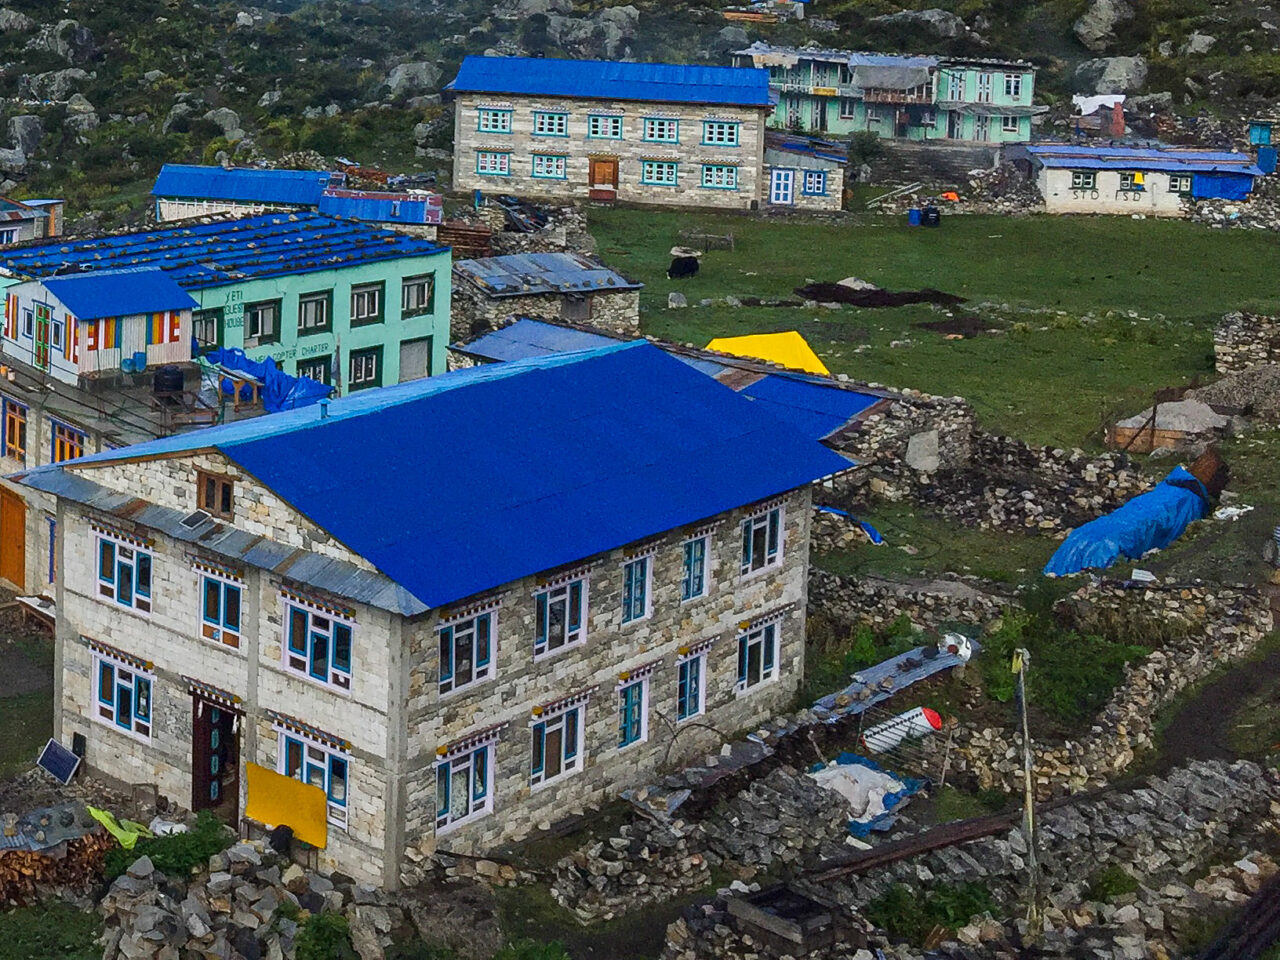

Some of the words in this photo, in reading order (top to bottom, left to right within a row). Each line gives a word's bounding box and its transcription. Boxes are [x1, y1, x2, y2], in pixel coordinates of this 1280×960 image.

[1073, 190, 1099, 200] STD
[225, 290, 243, 305] YETI
[301, 342, 329, 357] CHARTER
